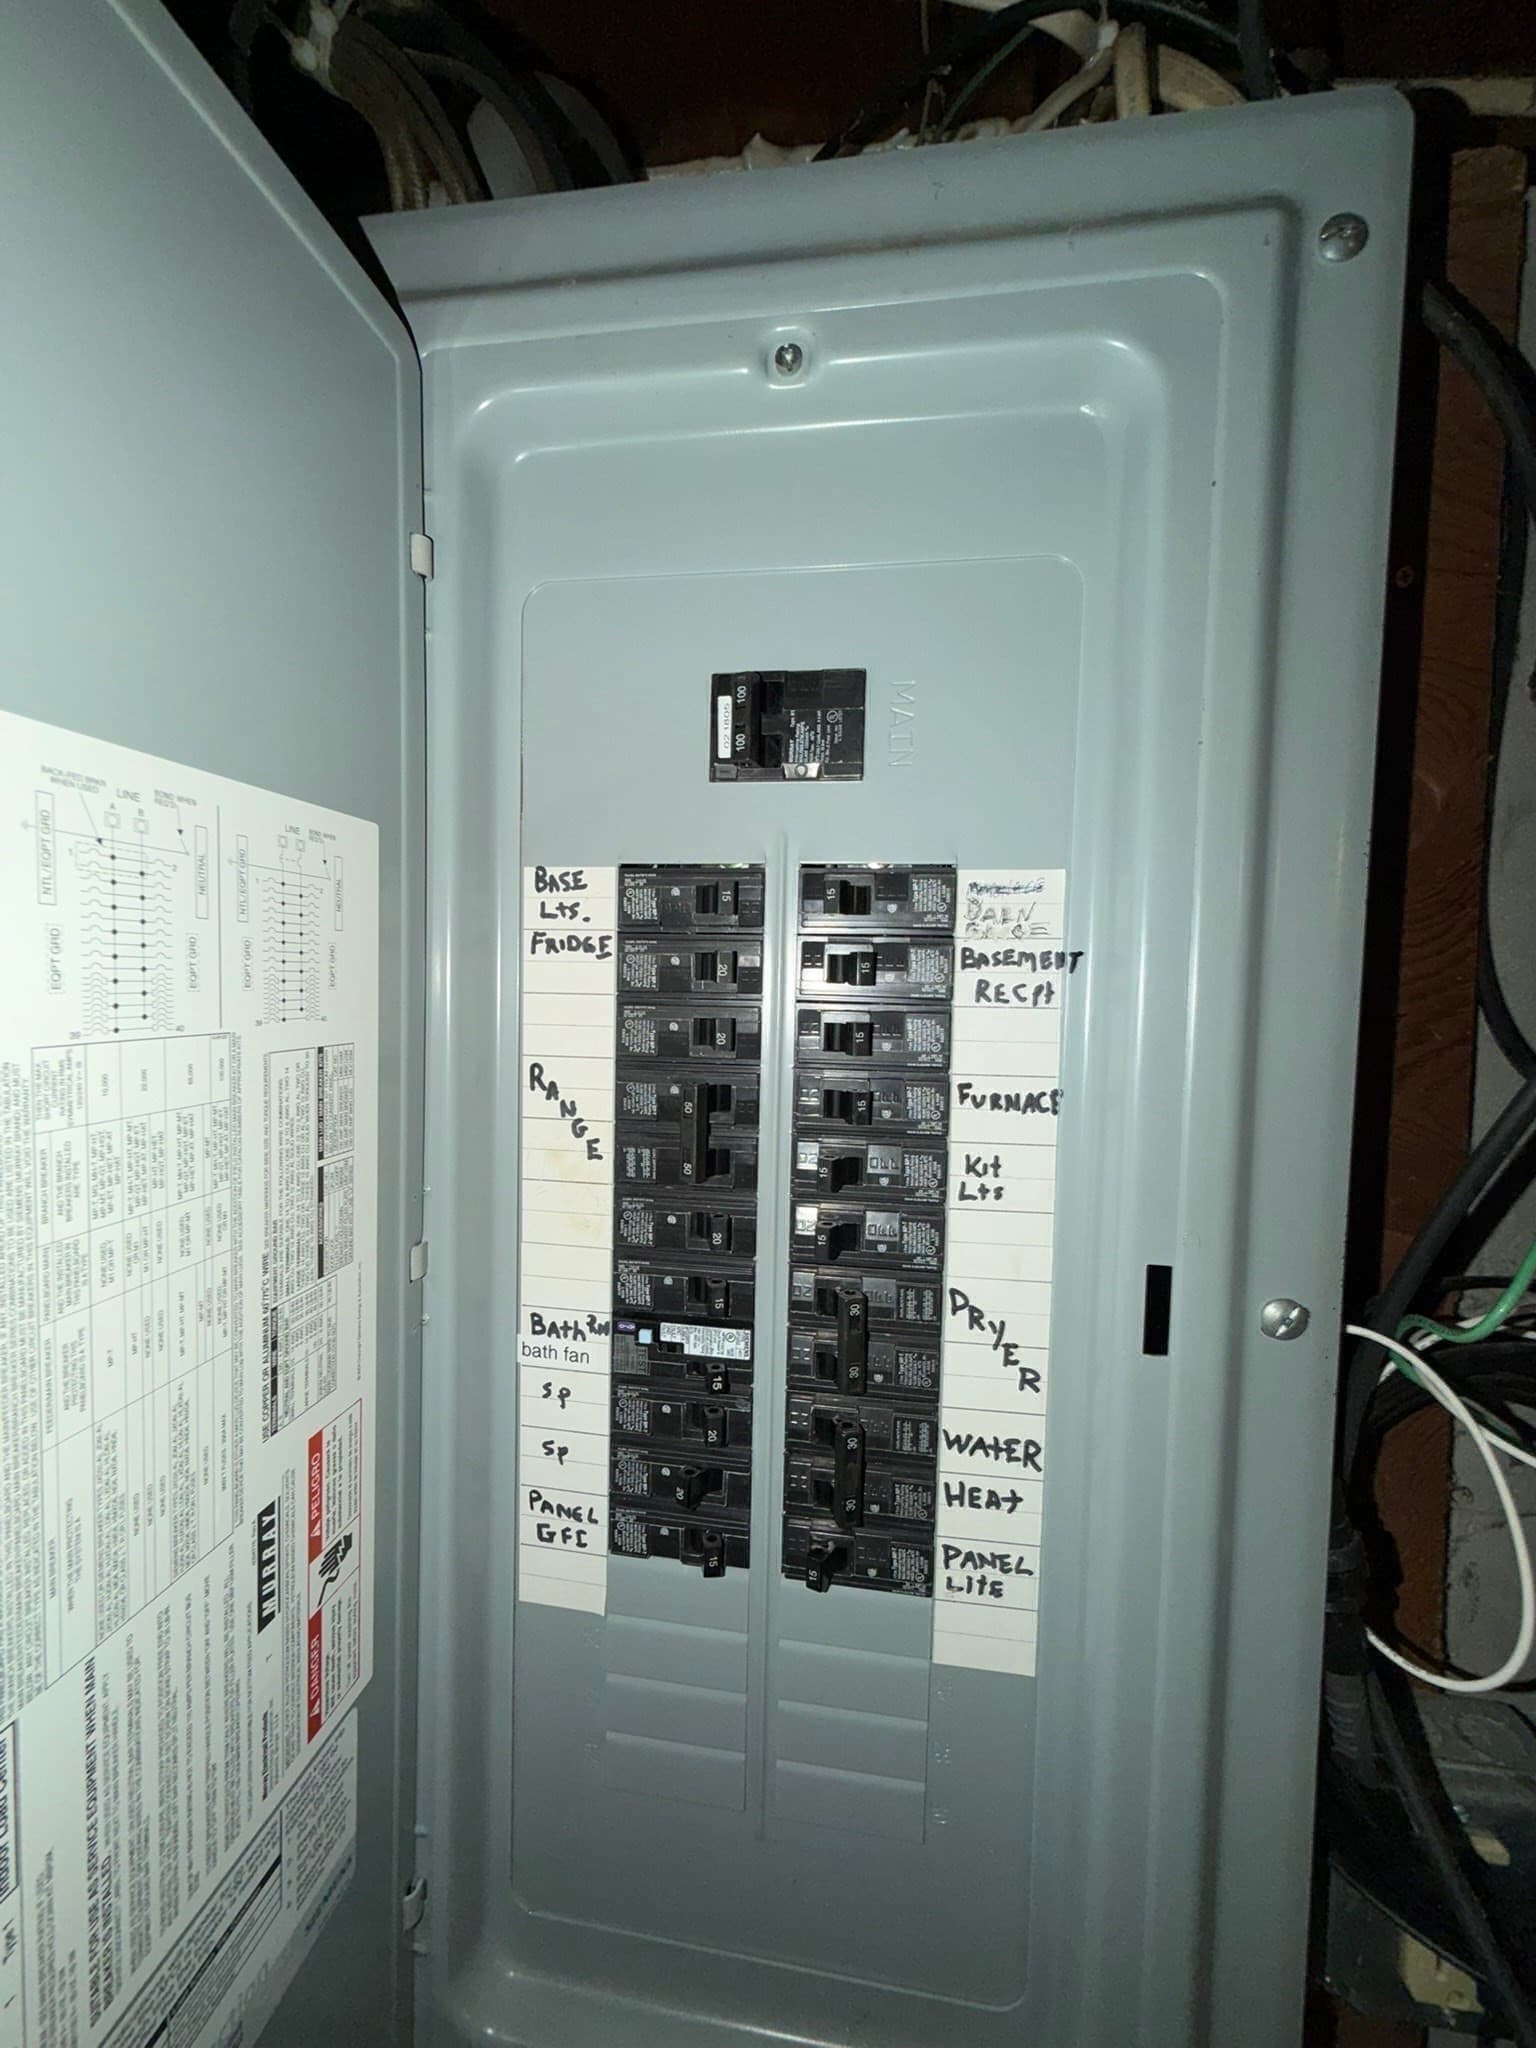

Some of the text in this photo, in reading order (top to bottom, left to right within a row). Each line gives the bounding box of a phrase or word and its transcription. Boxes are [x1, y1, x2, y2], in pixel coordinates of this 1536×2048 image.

[737, 686, 746, 703] 100
[888, 680, 918, 767] MAIN
[736, 734, 746, 752] 100
[116, 788, 141, 802] LINE
[285, 824, 300, 835] LINE
[39, 808, 52, 895] NTL/EQPT GRD
[534, 866, 588, 893] BASE
[722, 890, 731, 902] 15
[826, 888, 836, 899] 15
[530, 932, 612, 960] FRIDGE
[48, 927, 62, 990] EQPT GRD
[188, 935, 197, 988] EQPT GRD
[861, 962, 870, 973] 15
[961, 947, 1084, 974] BASEMENT
[718, 964, 728, 977] 20
[716, 1032, 726, 1045] 20
[856, 1032, 864, 1043] 15
[684, 1101, 693, 1114] 50
[858, 1100, 866, 1112] 15
[957, 1082, 1064, 1115] FURNACE
[530, 1062, 603, 1160] RANGE
[683, 1163, 692, 1175] 50
[819, 1167, 828, 1178] 15
[712, 1232, 722, 1245] 20
[818, 1235, 826, 1245] 15
[715, 1298, 724, 1309] 15
[850, 1304, 860, 1316] 30
[949, 1288, 1041, 1393] DRYER
[522, 1342, 590, 1364] bath fan
[712, 1376, 722, 1390] 15
[708, 1430, 717, 1442] 20
[848, 1437, 857, 1450] 30
[311, 1450, 319, 1521] PELIGRO
[529, 1489, 599, 1524] PANEL
[846, 1500, 856, 1512] 30
[537, 1523, 588, 1548] GFI
[261, 1504, 276, 1622] MURRAY
[709, 1557, 718, 1568] 15
[942, 1544, 1034, 1576] PANEL
[809, 1570, 818, 1581] 15
[84, 1654, 95, 1696] MAIN
[310, 1632, 319, 1701] DANGER
[85, 1693, 96, 1740] WHEN
[86, 1736, 97, 1822] EQUIPMENT
[87, 1816, 98, 1882] SERVICE
[88, 1896, 98, 1933] USE
[89, 1926, 99, 1964] FOR
